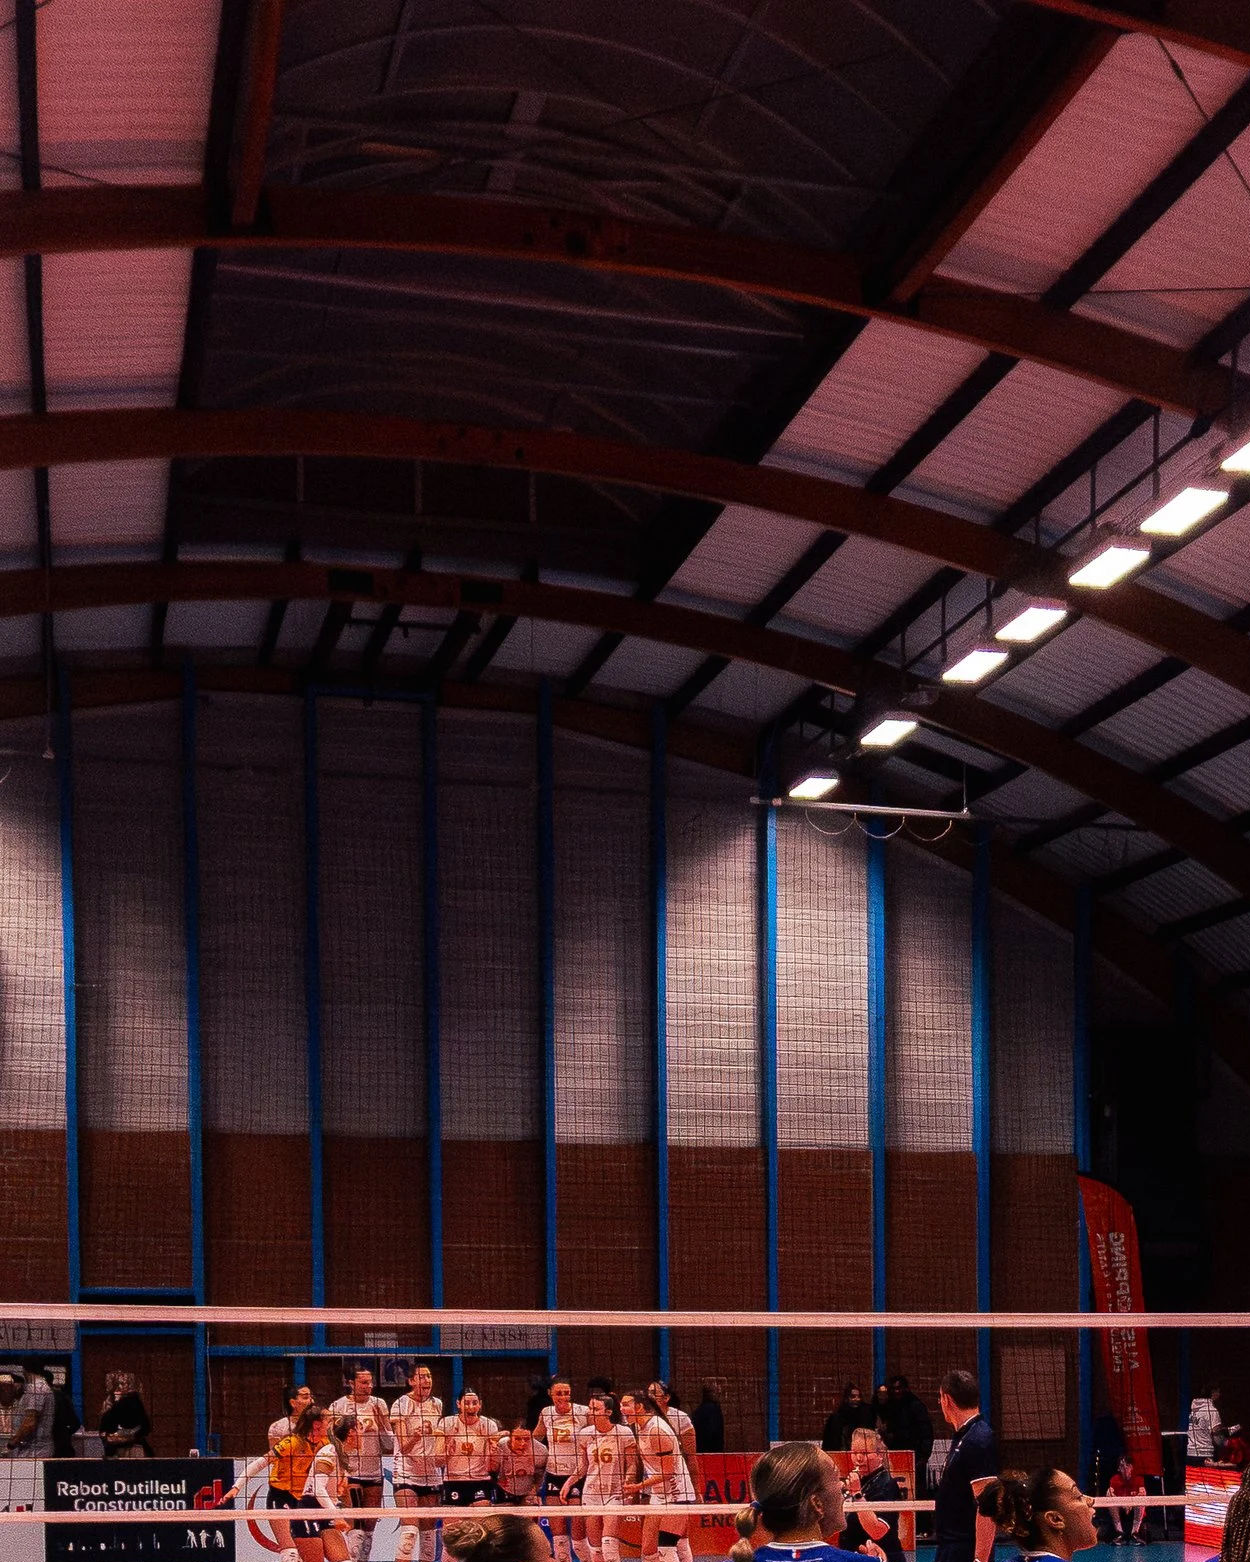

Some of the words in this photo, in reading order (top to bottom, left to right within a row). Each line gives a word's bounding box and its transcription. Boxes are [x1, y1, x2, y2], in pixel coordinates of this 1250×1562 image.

[592, 1448, 613, 1464] 16
[57, 1481, 109, 1496] Rabot
[114, 1480, 186, 1495] Dutilleul
[74, 1498, 187, 1512] Construction
